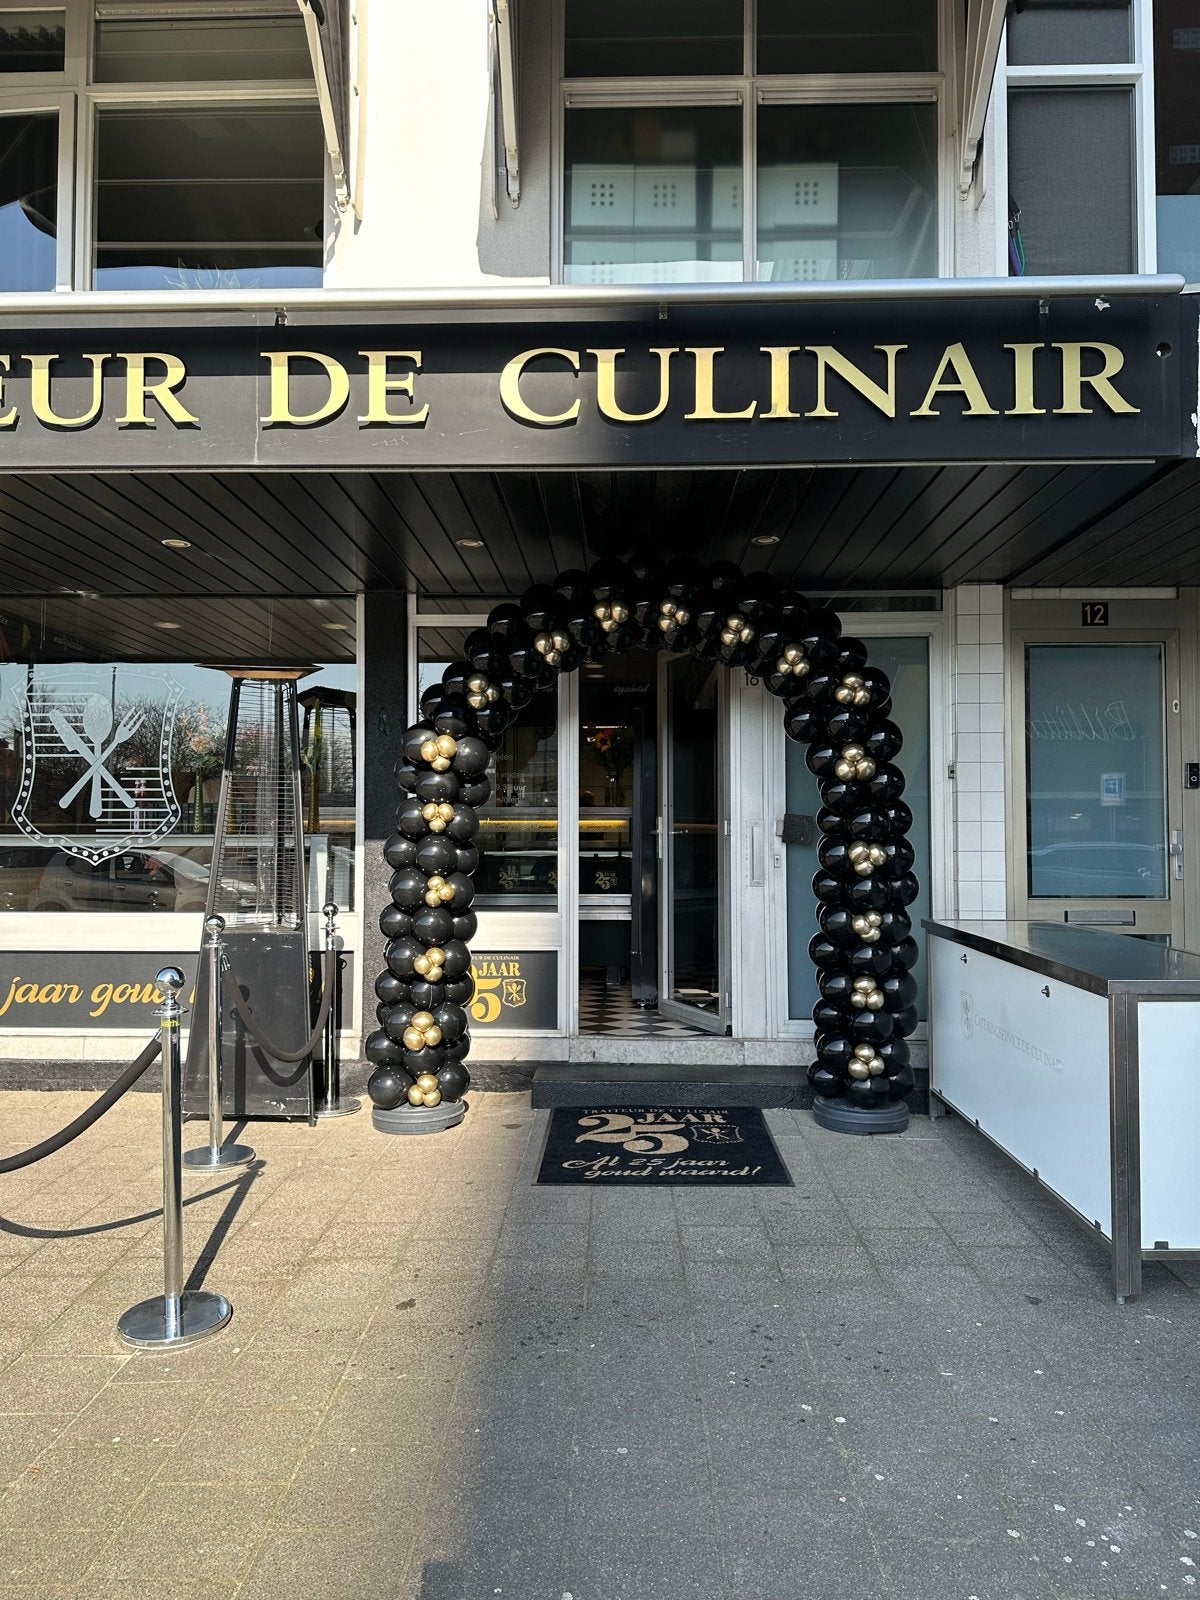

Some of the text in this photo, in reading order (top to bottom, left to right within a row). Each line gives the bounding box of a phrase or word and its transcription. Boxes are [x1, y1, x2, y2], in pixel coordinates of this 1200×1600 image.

[0, 342, 1141, 426] UR DE CULINAIR
[1084, 604, 1105, 624] 12
[479, 962, 521, 977] JAAR
[0, 976, 84, 1017] jaar
[575, 1112, 728, 1155] 25 JAAR
[561, 1155, 730, 1171] Al 25 jaar
[583, 1166, 762, 1179] goud waard!
